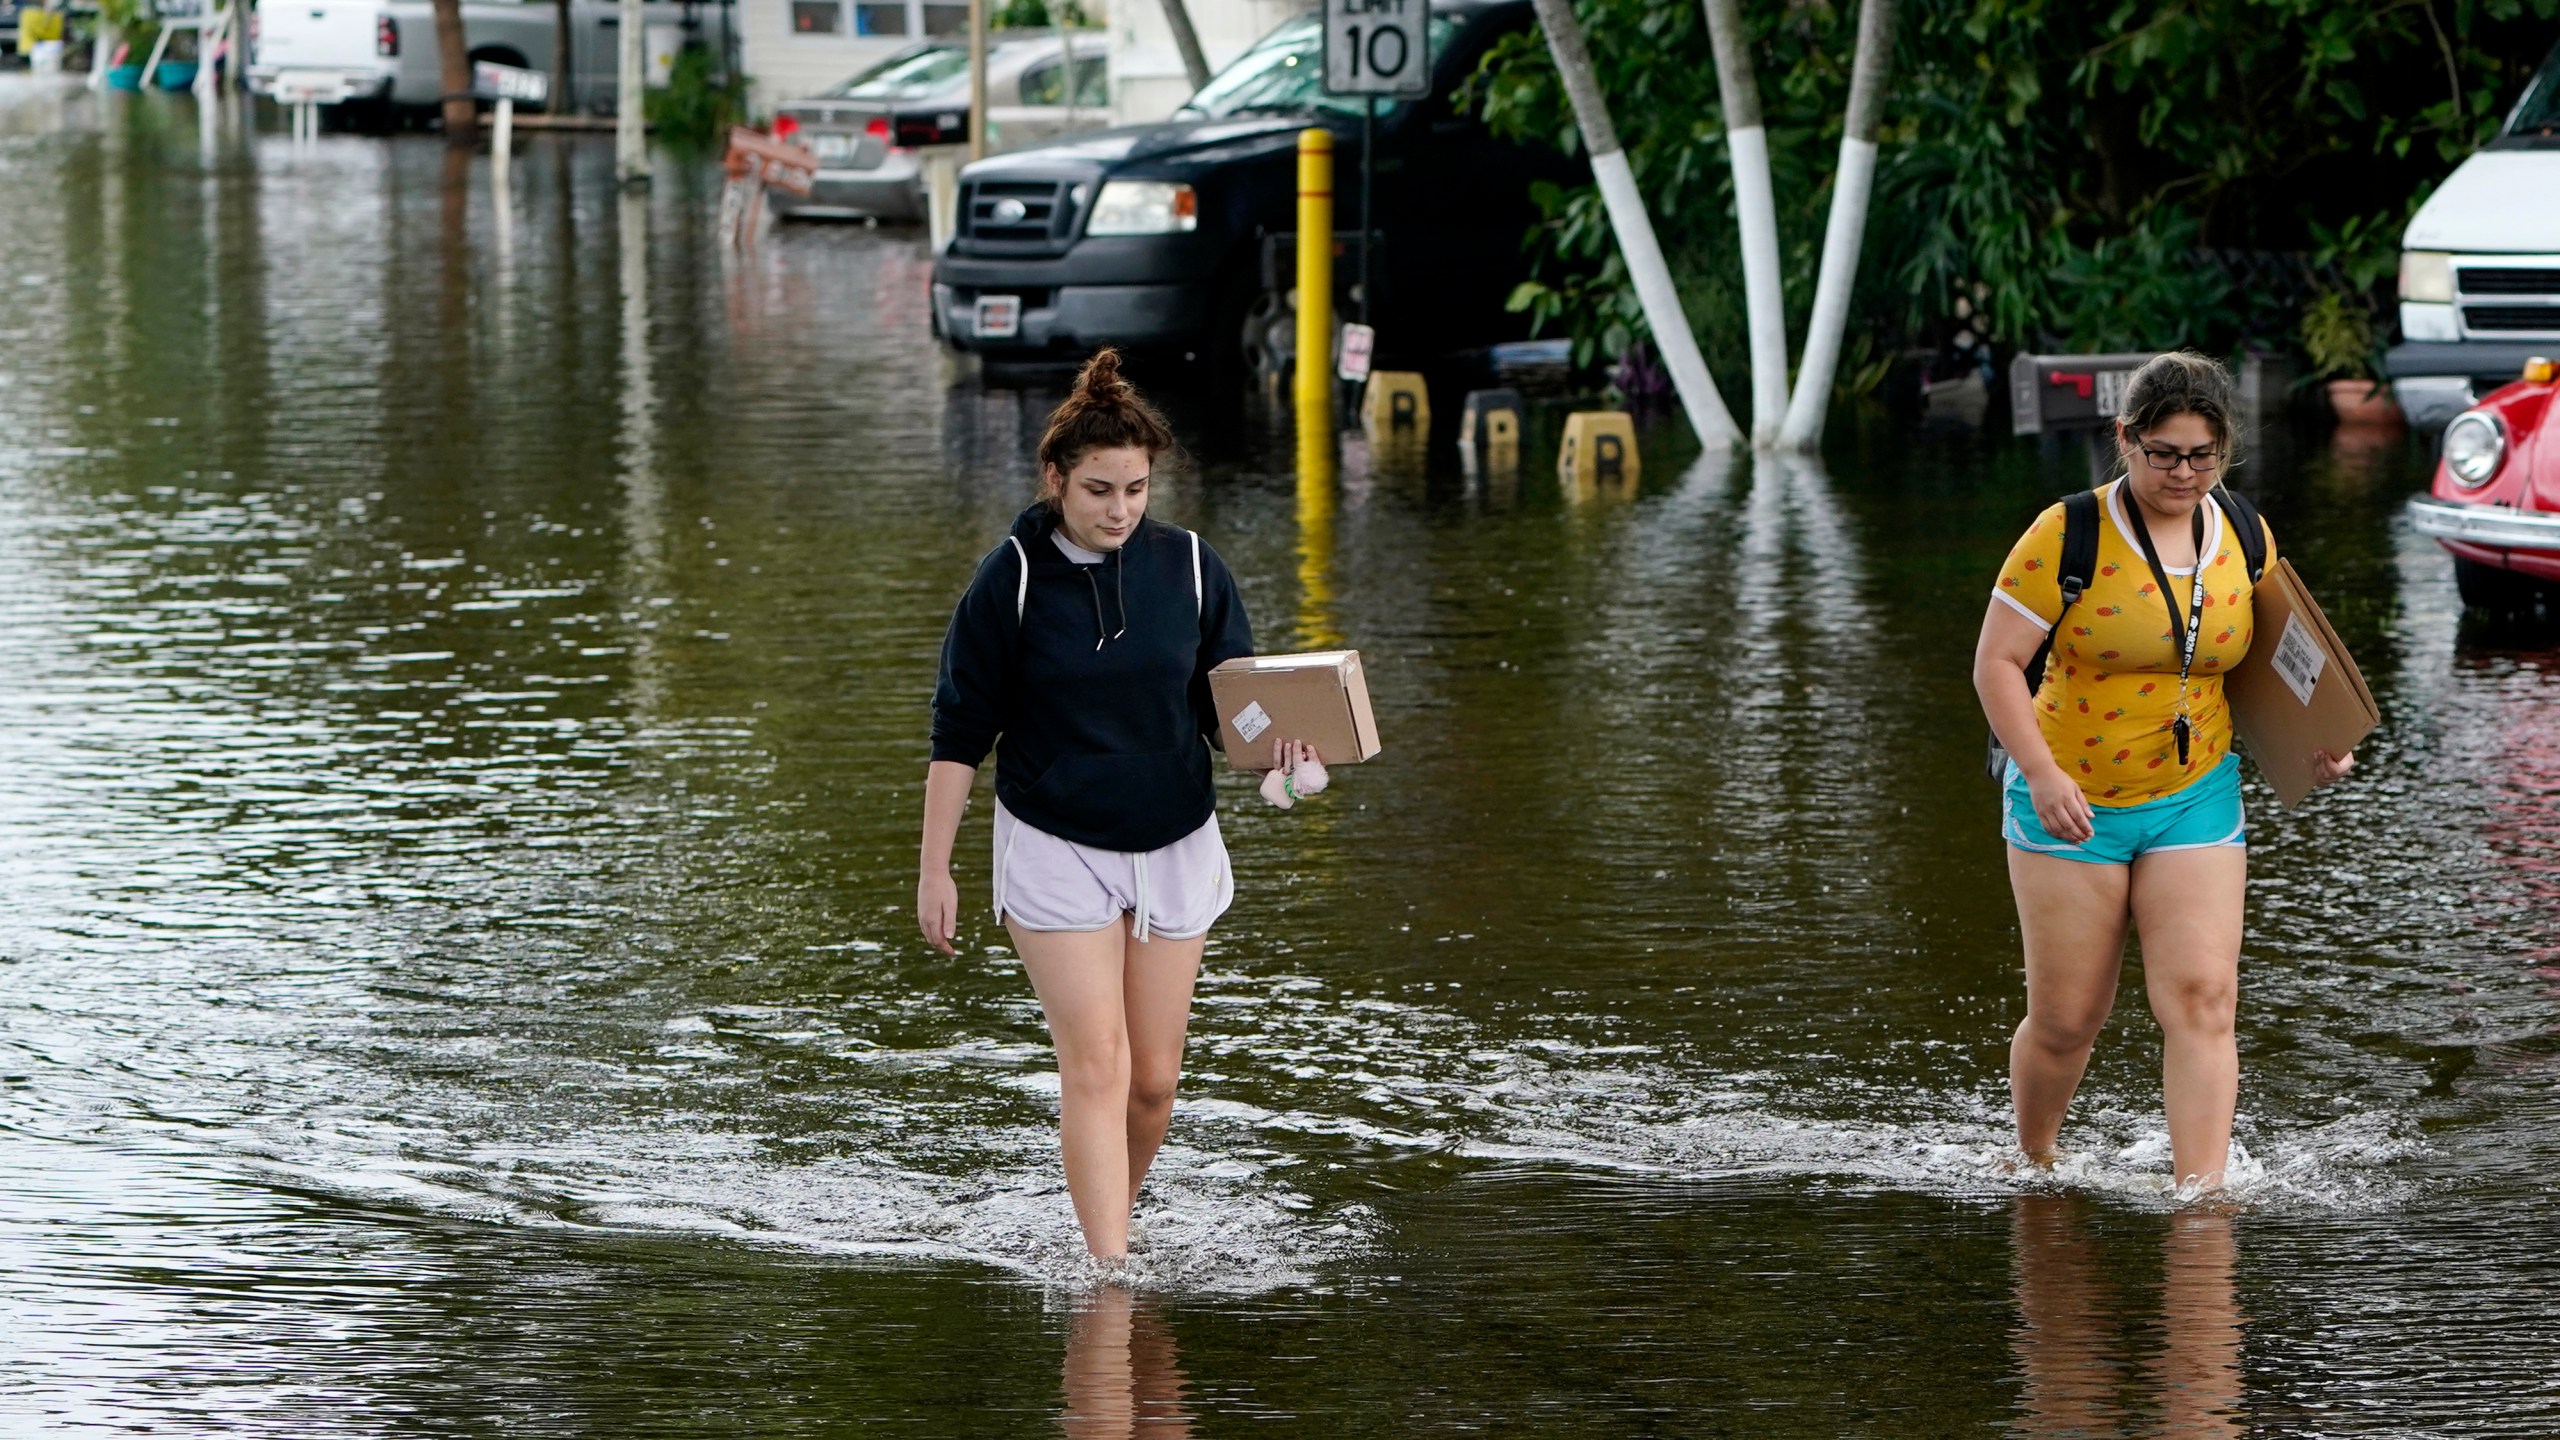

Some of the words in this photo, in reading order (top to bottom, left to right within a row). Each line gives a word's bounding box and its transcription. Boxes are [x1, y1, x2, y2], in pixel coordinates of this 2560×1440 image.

[1346, 25, 1408, 78] 10
[2192, 584, 2204, 607] GRAD
[2185, 630, 2197, 653] 2020
